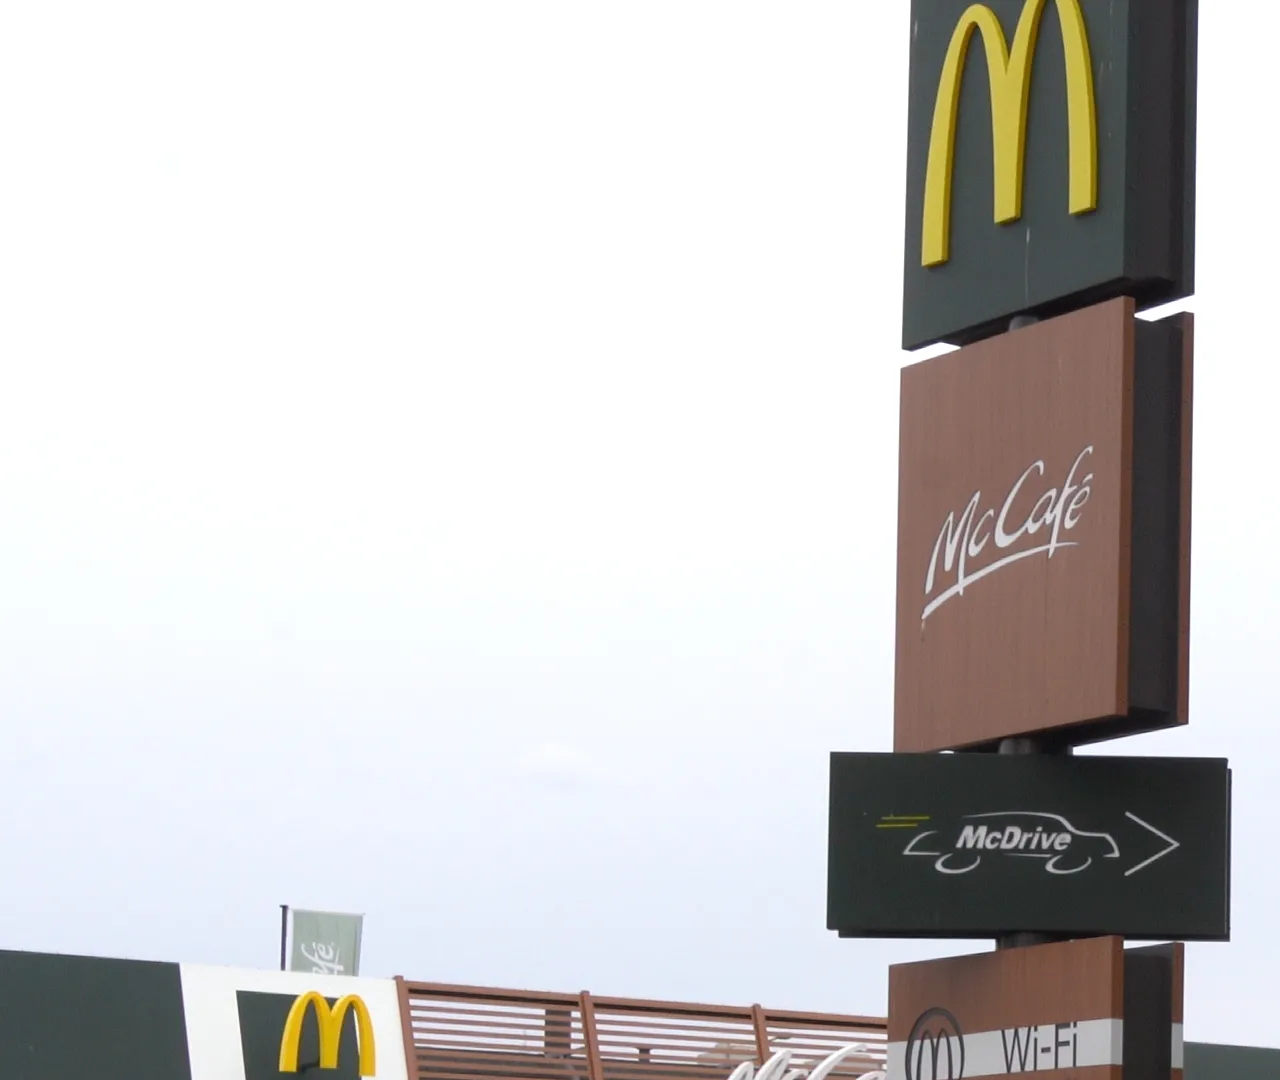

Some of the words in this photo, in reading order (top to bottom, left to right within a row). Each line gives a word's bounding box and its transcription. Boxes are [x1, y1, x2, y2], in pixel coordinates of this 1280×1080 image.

[922, 445, 1095, 600] McCafé
[955, 824, 1072, 851] McDrive
[1001, 1021, 1077, 1074] Wi-Fi
